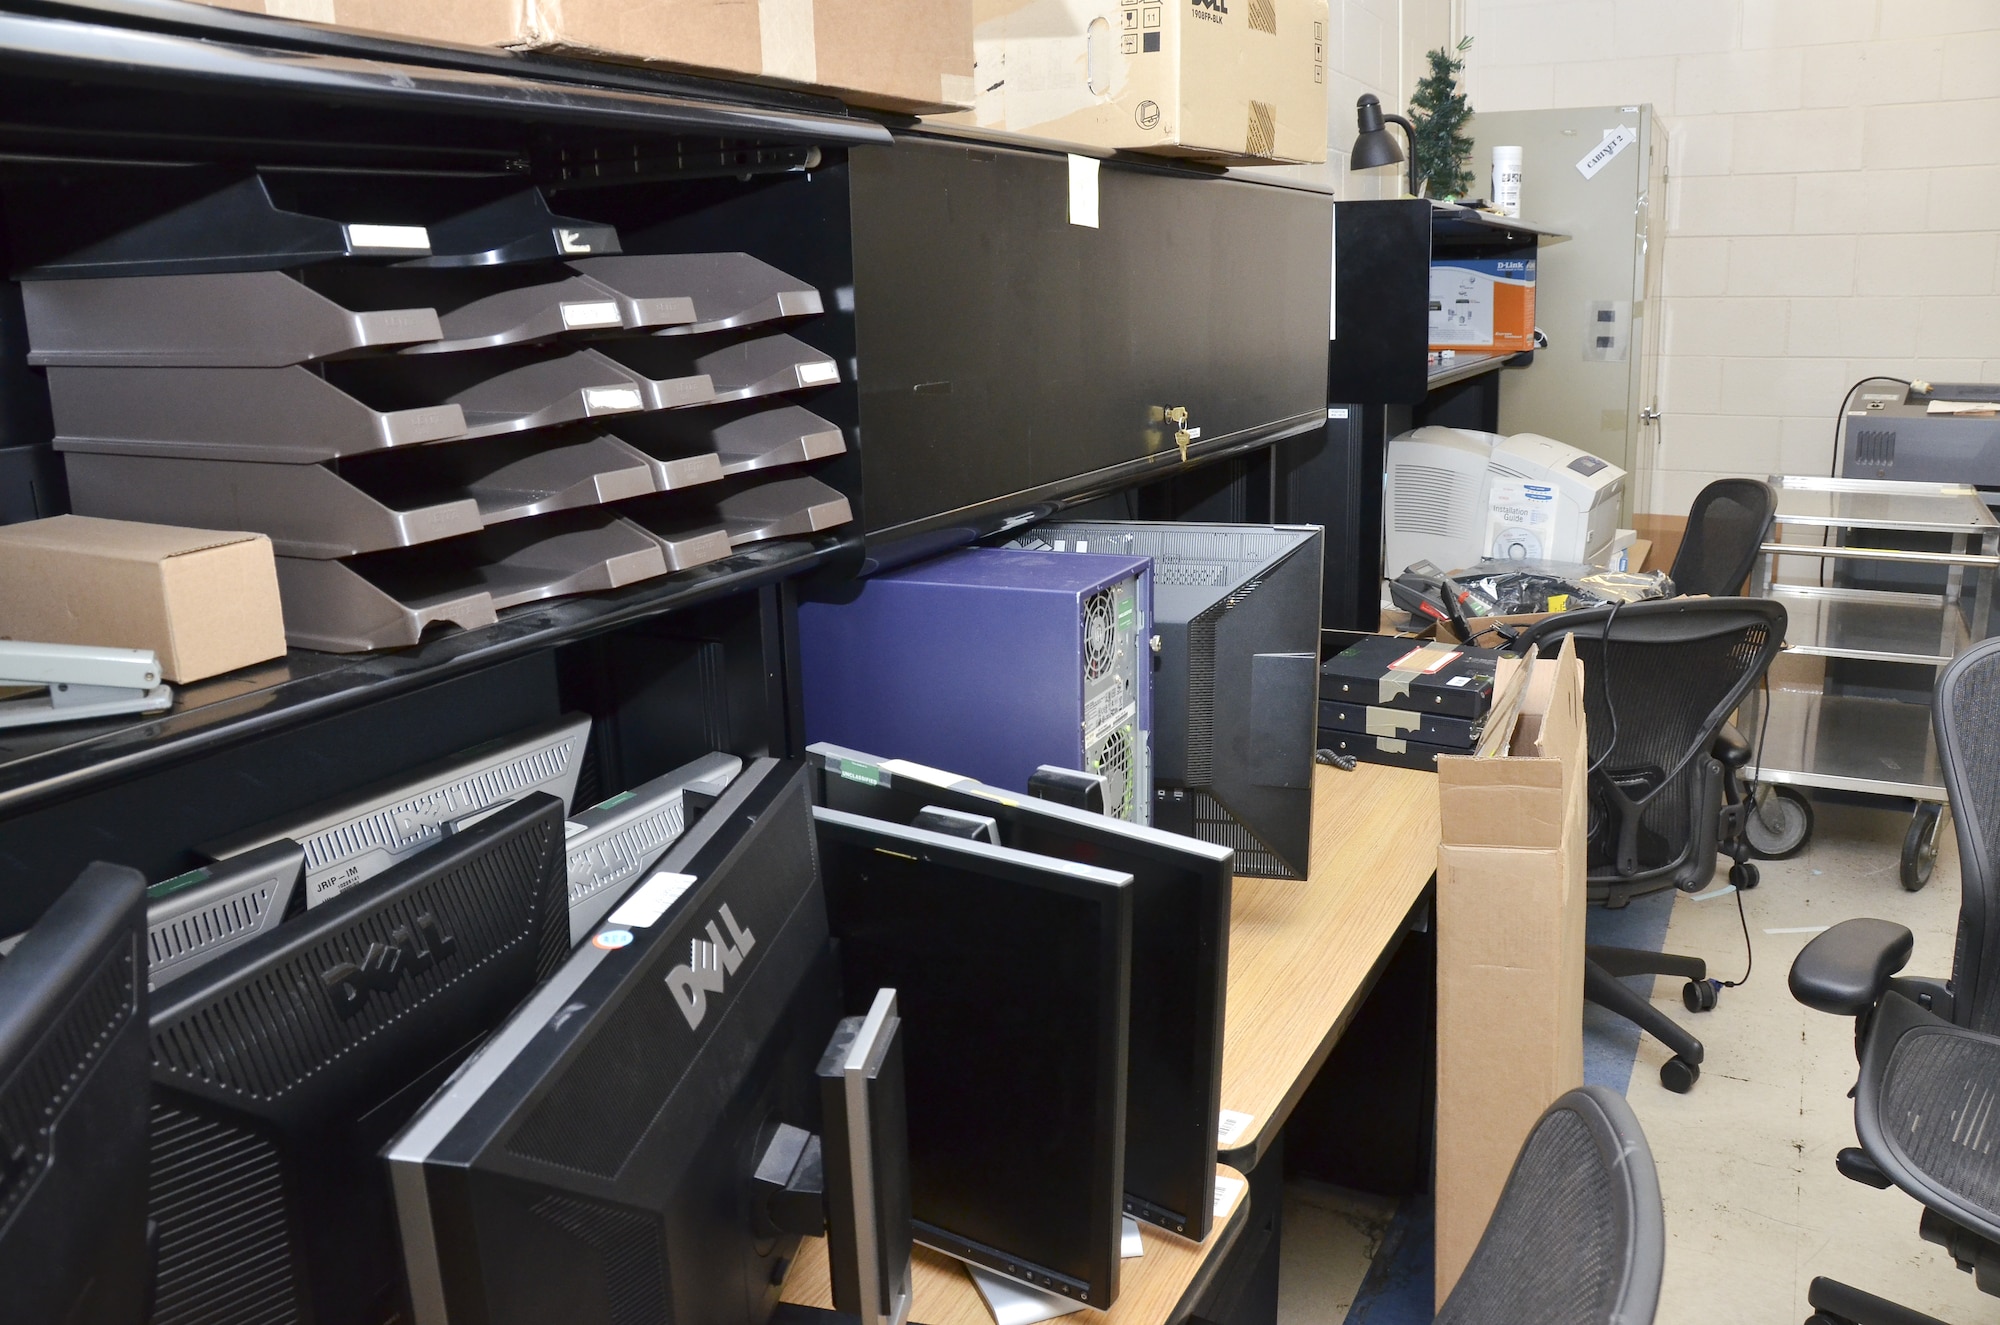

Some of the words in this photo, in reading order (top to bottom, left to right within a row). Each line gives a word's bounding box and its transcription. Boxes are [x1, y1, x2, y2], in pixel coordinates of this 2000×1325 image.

[1192, 9, 1223, 24] 1908FP-BLK
[1587, 139, 1617, 168] CABINET
[1493, 505, 1528, 516] Installation
[1504, 513, 1523, 522] Guide
[567, 833, 622, 885] ELL
[321, 912, 457, 1021] DELL
[665, 902, 756, 1031] DELL
